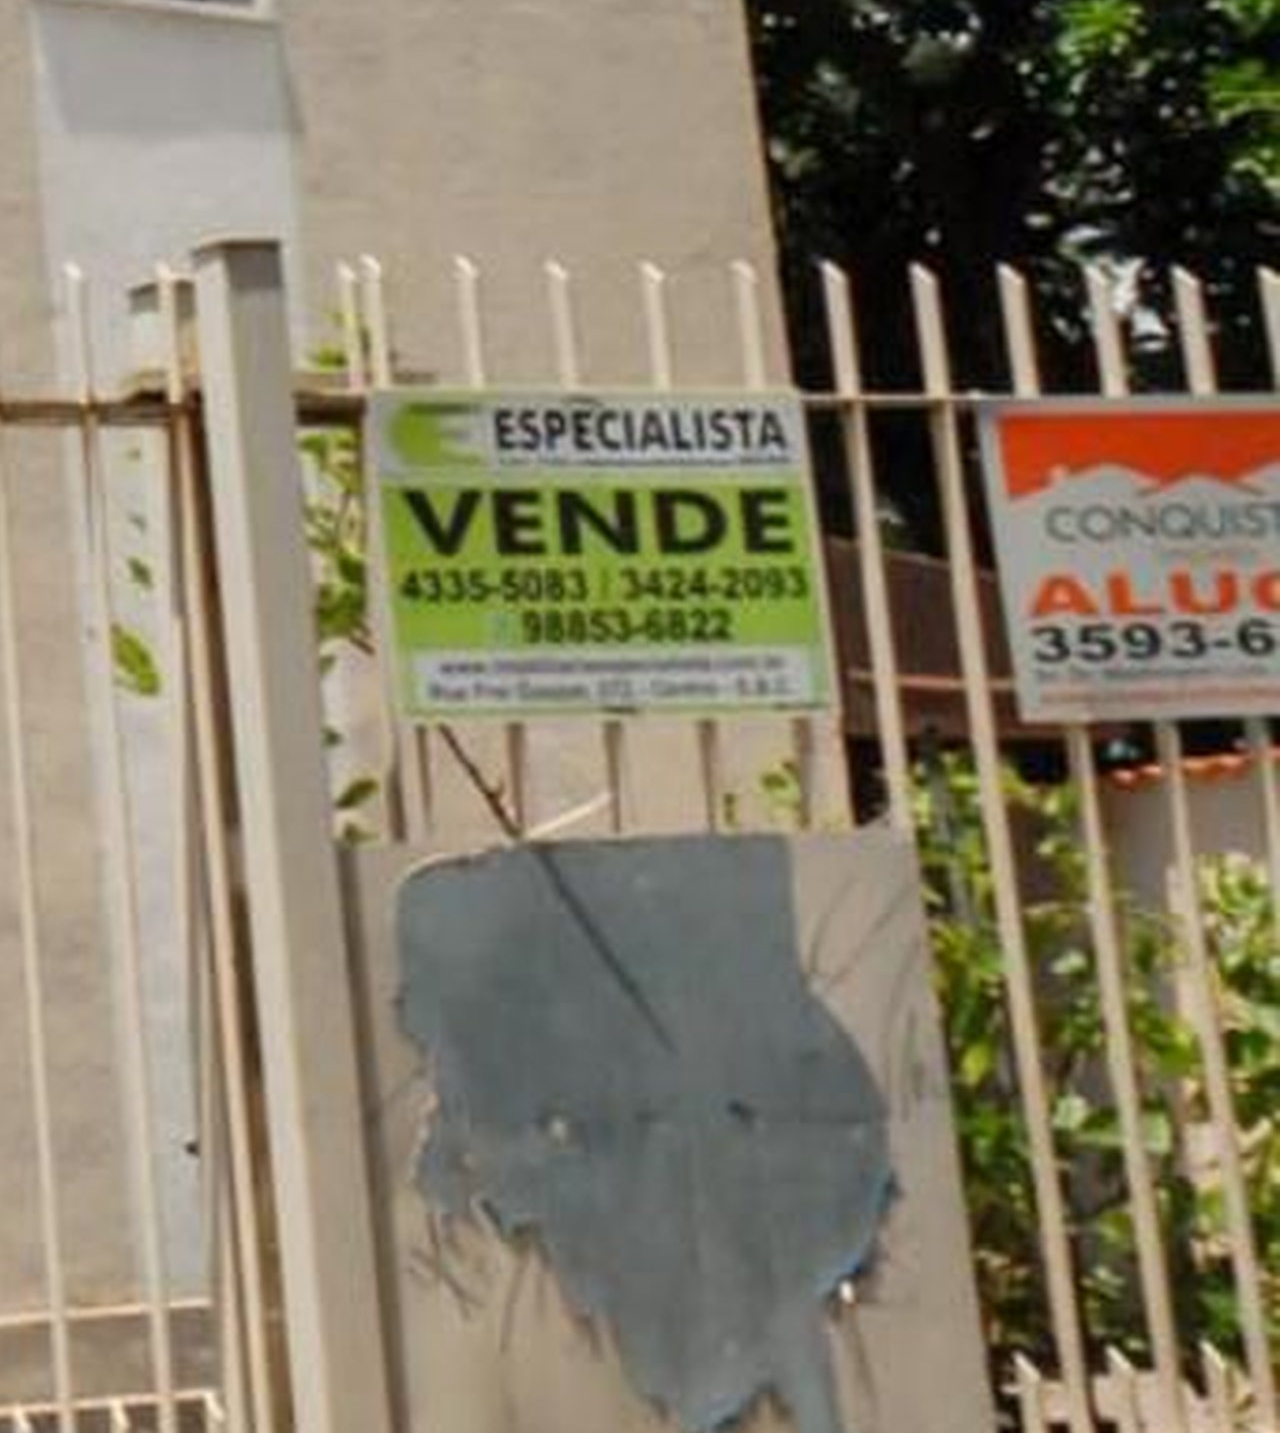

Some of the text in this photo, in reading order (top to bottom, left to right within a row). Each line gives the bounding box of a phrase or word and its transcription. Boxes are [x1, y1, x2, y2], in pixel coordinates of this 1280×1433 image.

[493, 408, 788, 452] ESPECIALISTA
[402, 487, 795, 557] VENDE
[400, 566, 810, 602] 4335-5083 3424-2093
